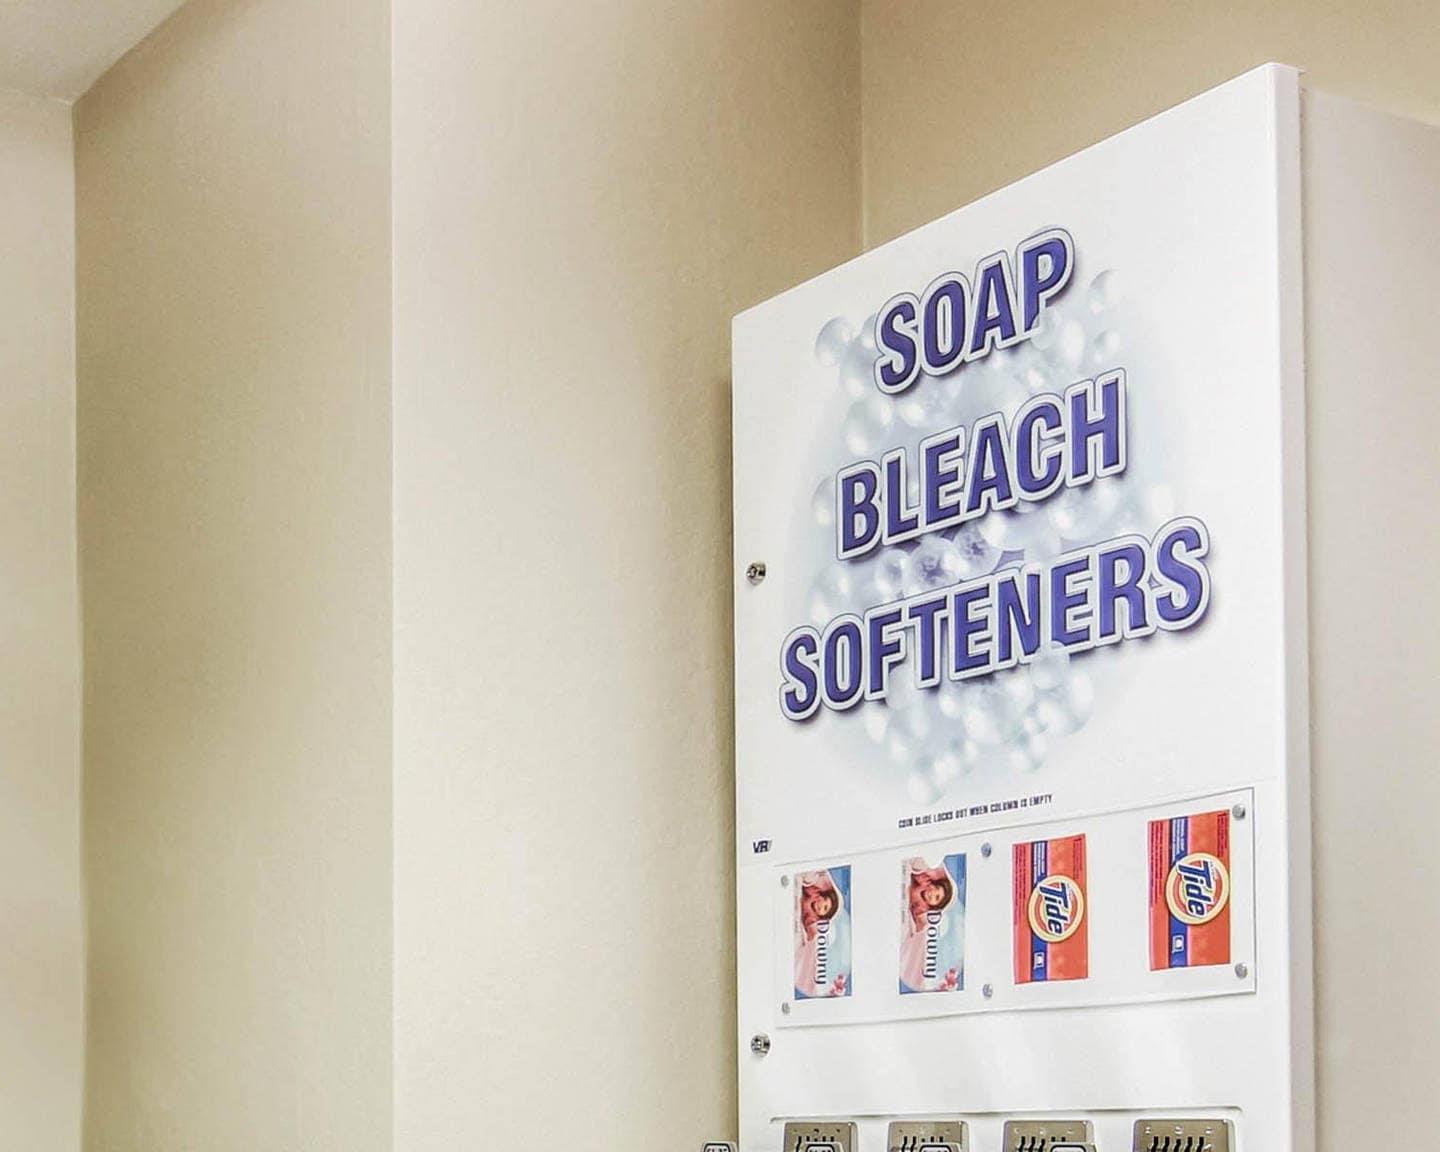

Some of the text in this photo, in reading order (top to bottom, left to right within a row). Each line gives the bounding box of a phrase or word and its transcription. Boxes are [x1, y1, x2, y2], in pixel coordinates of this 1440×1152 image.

[878, 233, 1071, 389] SOAP
[840, 374, 1123, 556] BLEACH
[782, 522, 1210, 718] SOFTENERS
[1029, 794, 1053, 807] EMPTY
[1039, 881, 1069, 935] Tide
[1177, 859, 1213, 917] Tide
[814, 919, 830, 985] Downy
[923, 911, 942, 979] Downy
